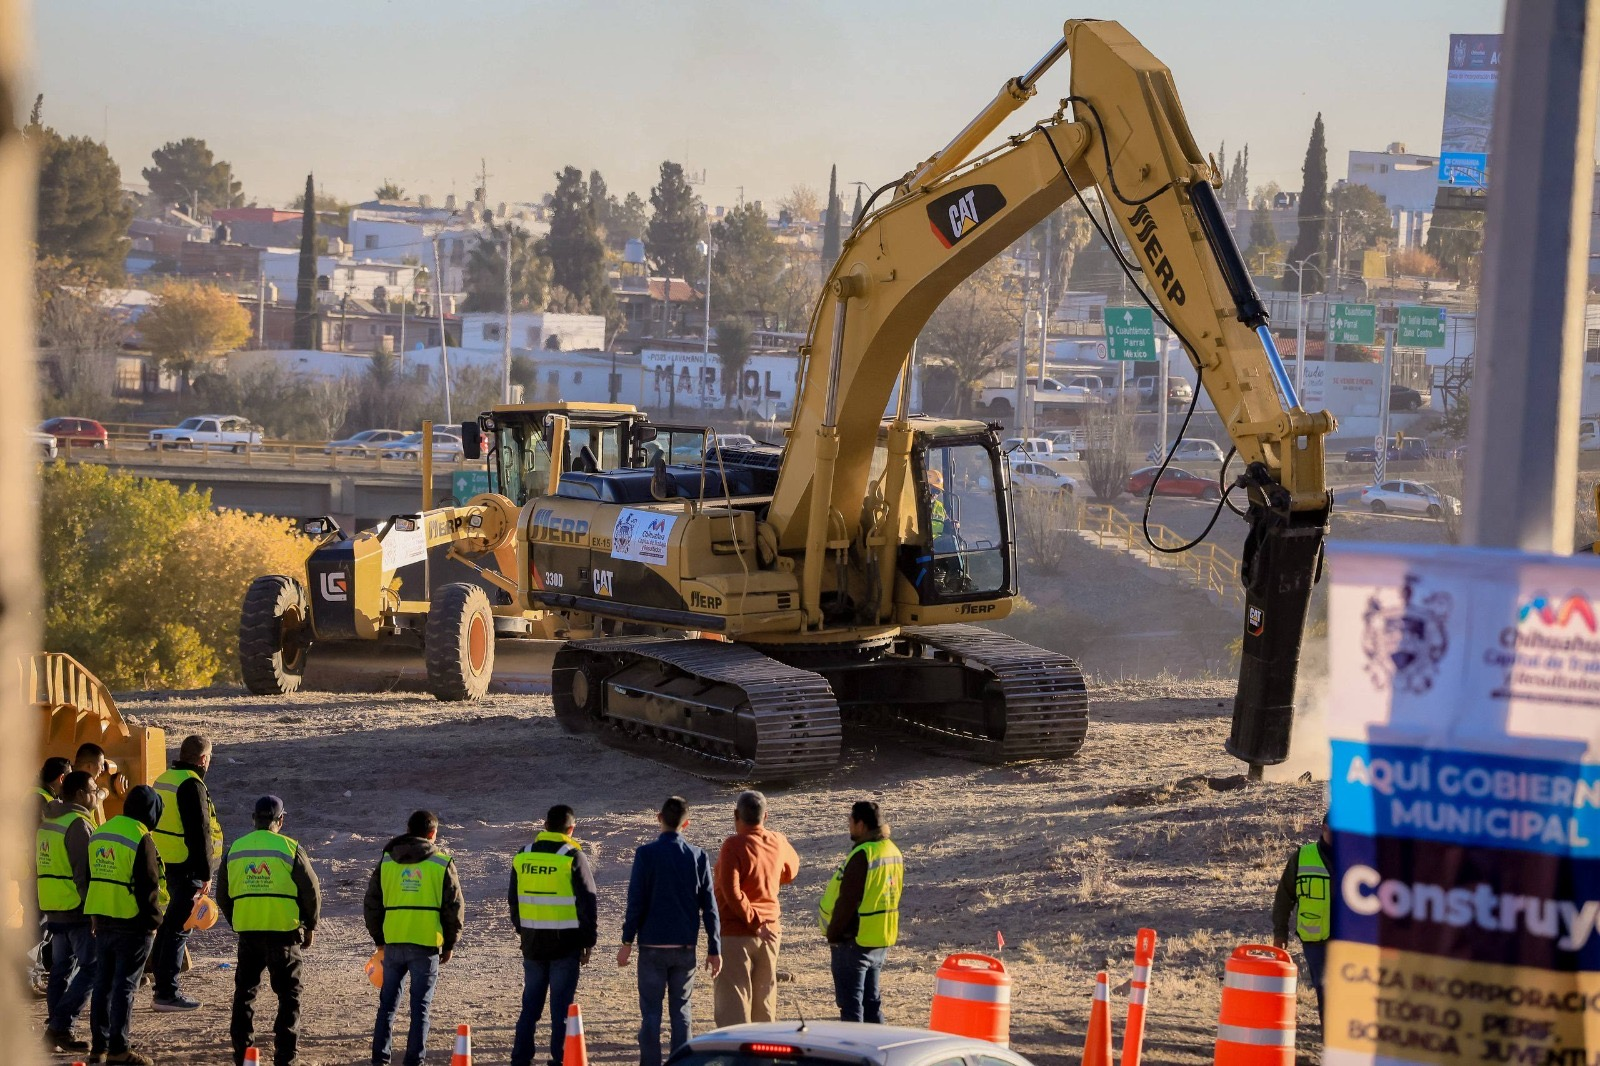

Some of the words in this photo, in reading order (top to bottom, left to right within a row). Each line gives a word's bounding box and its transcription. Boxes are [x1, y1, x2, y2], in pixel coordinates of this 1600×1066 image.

[948, 189, 979, 238] CAT
[1344, 319, 1358, 329] Parral
[1416, 328, 1433, 338] Centro
[1123, 338, 1146, 347] Parral
[654, 364, 781, 399] MAROL
[592, 537, 611, 548] EX-15
[545, 572, 564, 588] 330D
[593, 568, 614, 597] CAT
[1250, 607, 1261, 622] CAT
[1346, 755, 1431, 796] AQUÍ
[1390, 798, 1590, 848] MUNICIPAL
[1341, 863, 1600, 951] Construy
